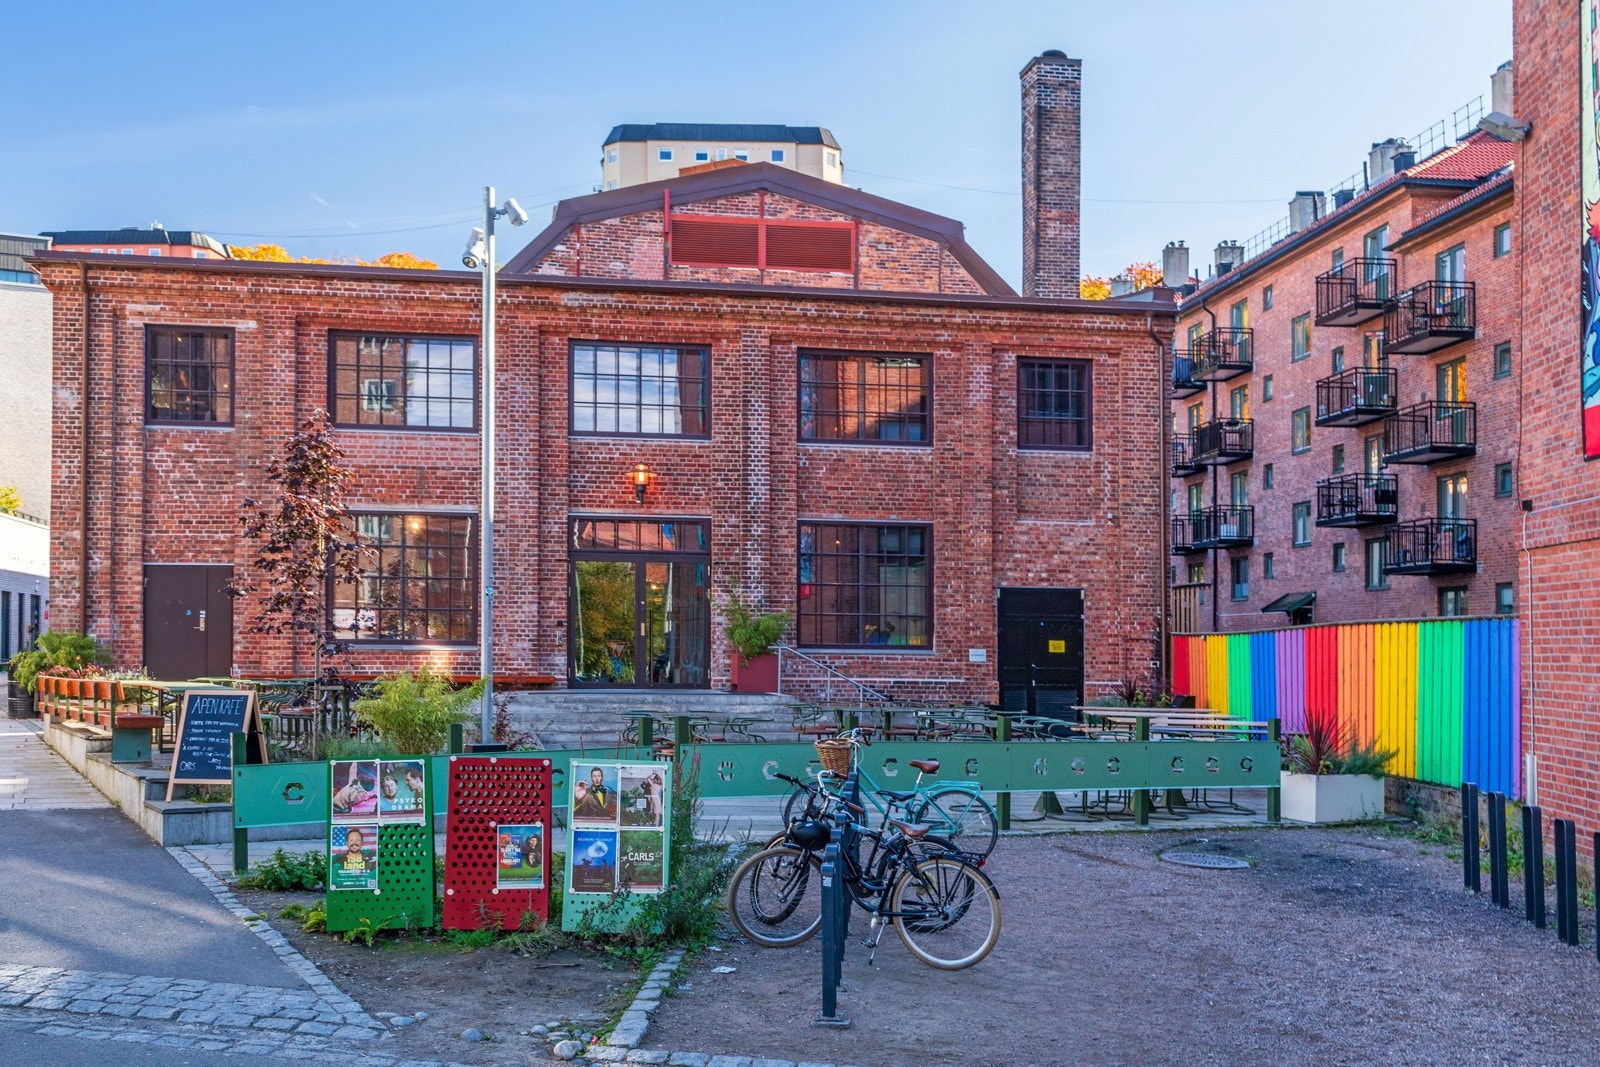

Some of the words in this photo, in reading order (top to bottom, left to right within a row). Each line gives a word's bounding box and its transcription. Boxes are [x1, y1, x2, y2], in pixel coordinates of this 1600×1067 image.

[191, 696, 218, 714] ÅPEN
[219, 696, 244, 715] KAFÉ
[628, 852, 655, 861] CARLS
[343, 861, 366, 870] land
